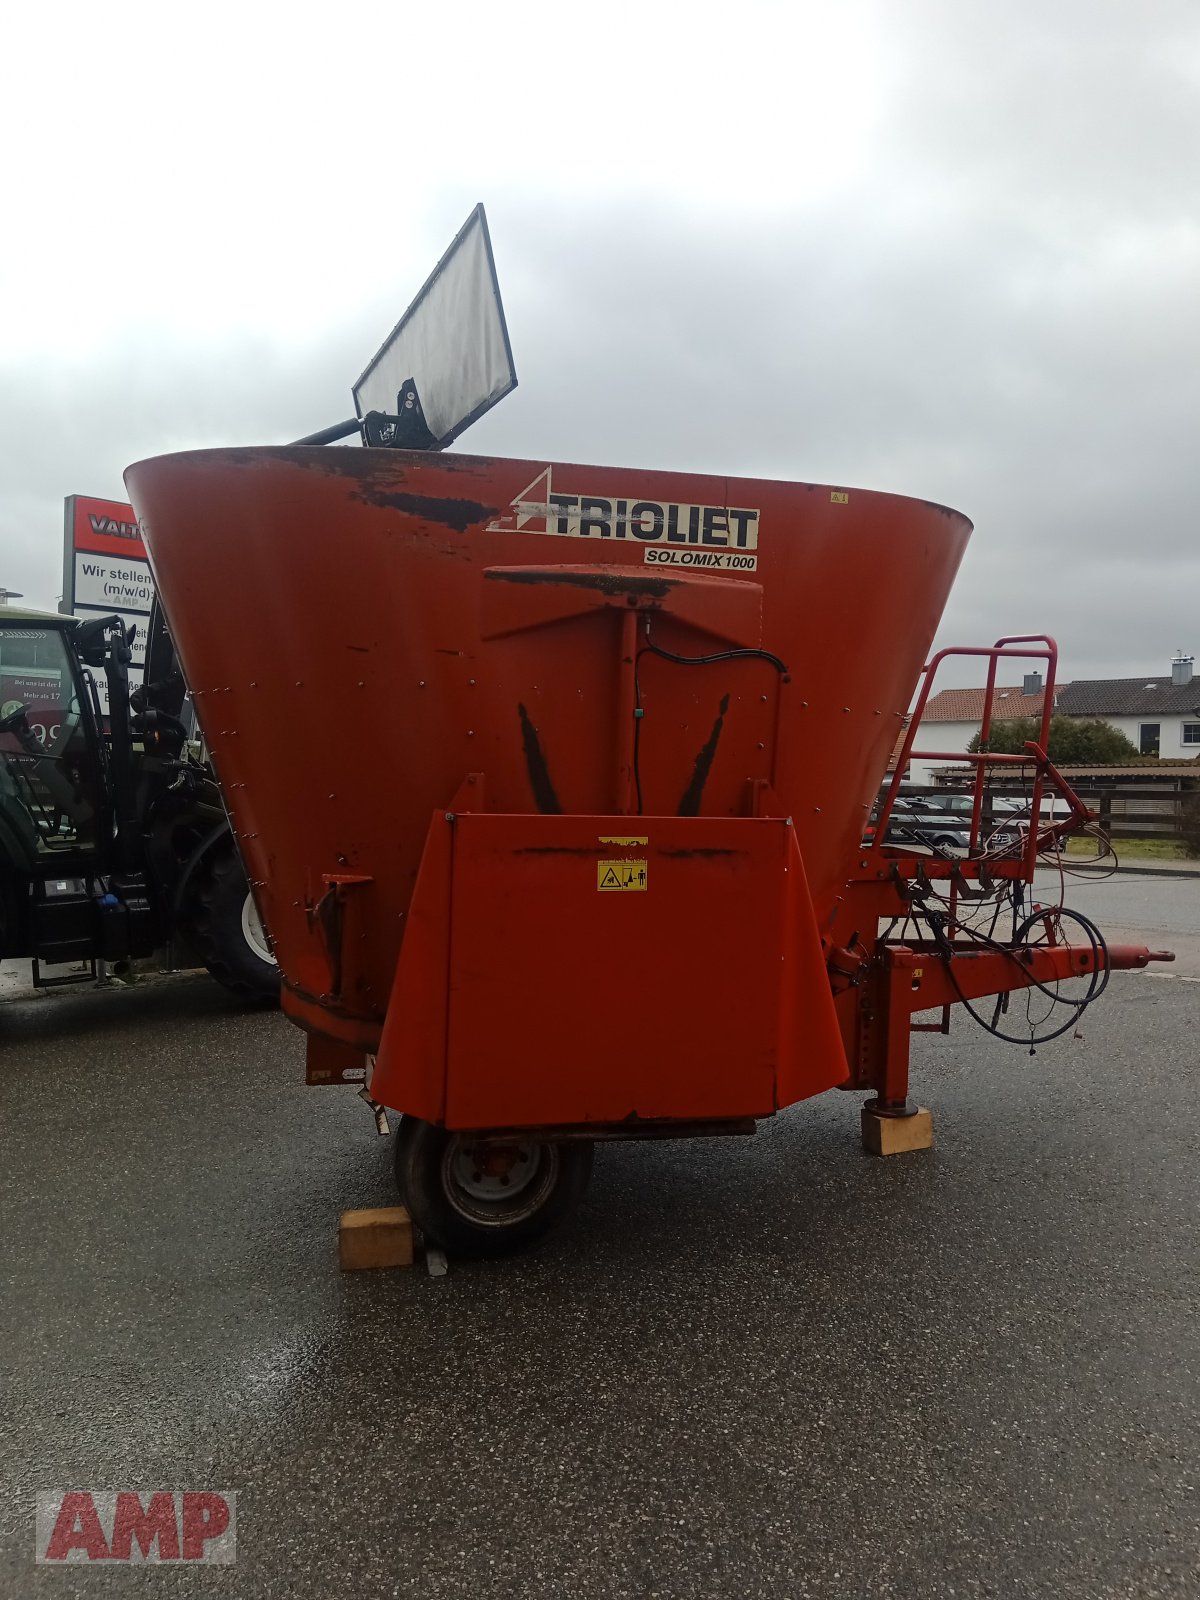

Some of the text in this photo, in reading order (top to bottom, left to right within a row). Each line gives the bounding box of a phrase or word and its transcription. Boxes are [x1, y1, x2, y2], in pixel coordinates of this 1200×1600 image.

[87, 513, 142, 541] VALT
[549, 493, 758, 548] TRIOLIET
[646, 549, 755, 570] SOLOMIX 1000
[82, 563, 152, 584] Wir stellen
[103, 582, 154, 602] (m/w/d):
